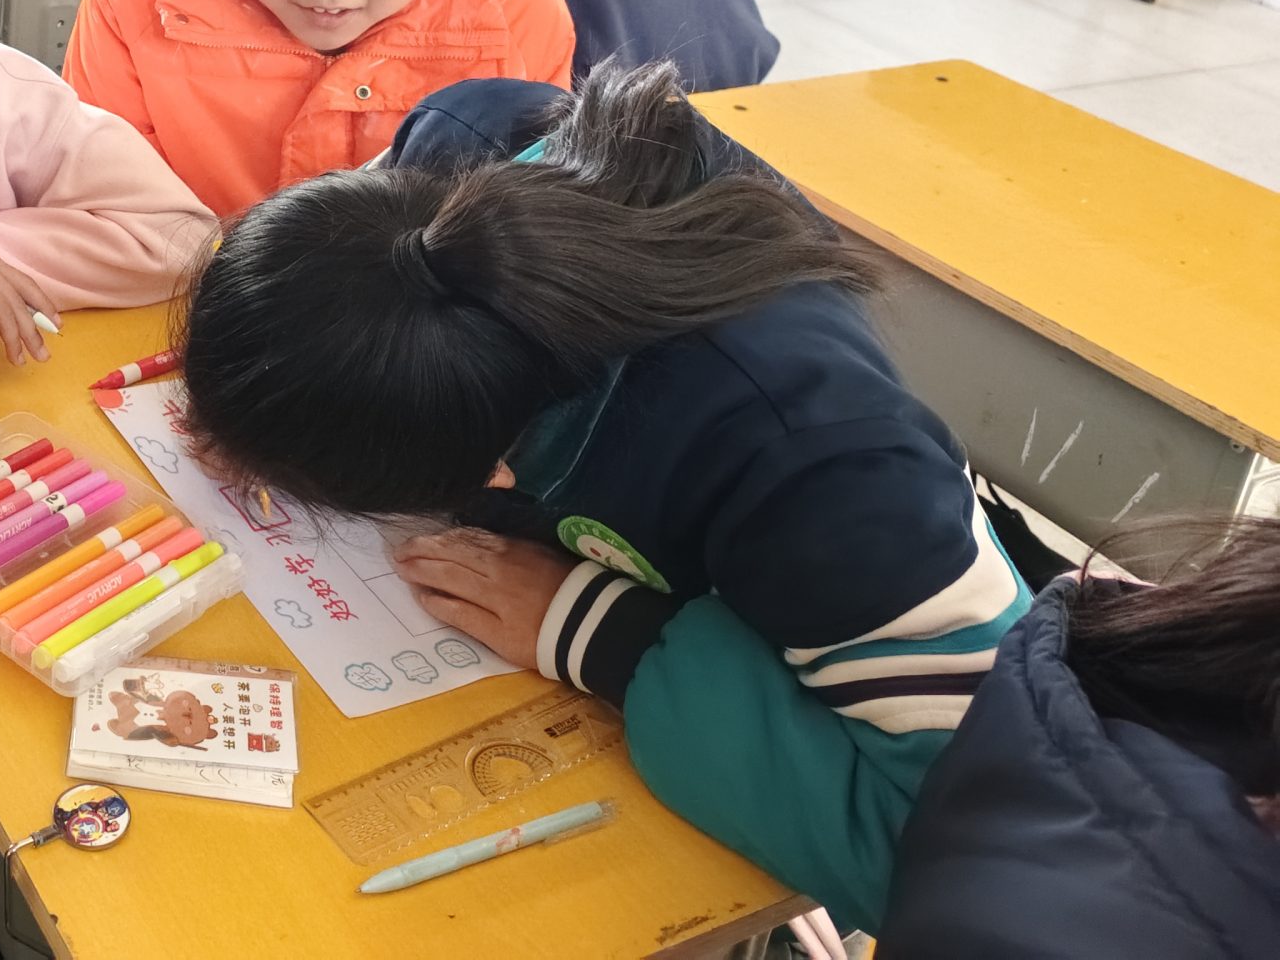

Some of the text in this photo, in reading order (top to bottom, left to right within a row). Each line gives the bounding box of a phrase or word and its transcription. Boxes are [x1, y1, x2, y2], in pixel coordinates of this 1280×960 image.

[266, 530, 360, 623] 好好学习
[221, 702, 236, 751] 人要想开
[236, 681, 252, 727] 茶要泡开
[268, 682, 284, 731] 保持理智
